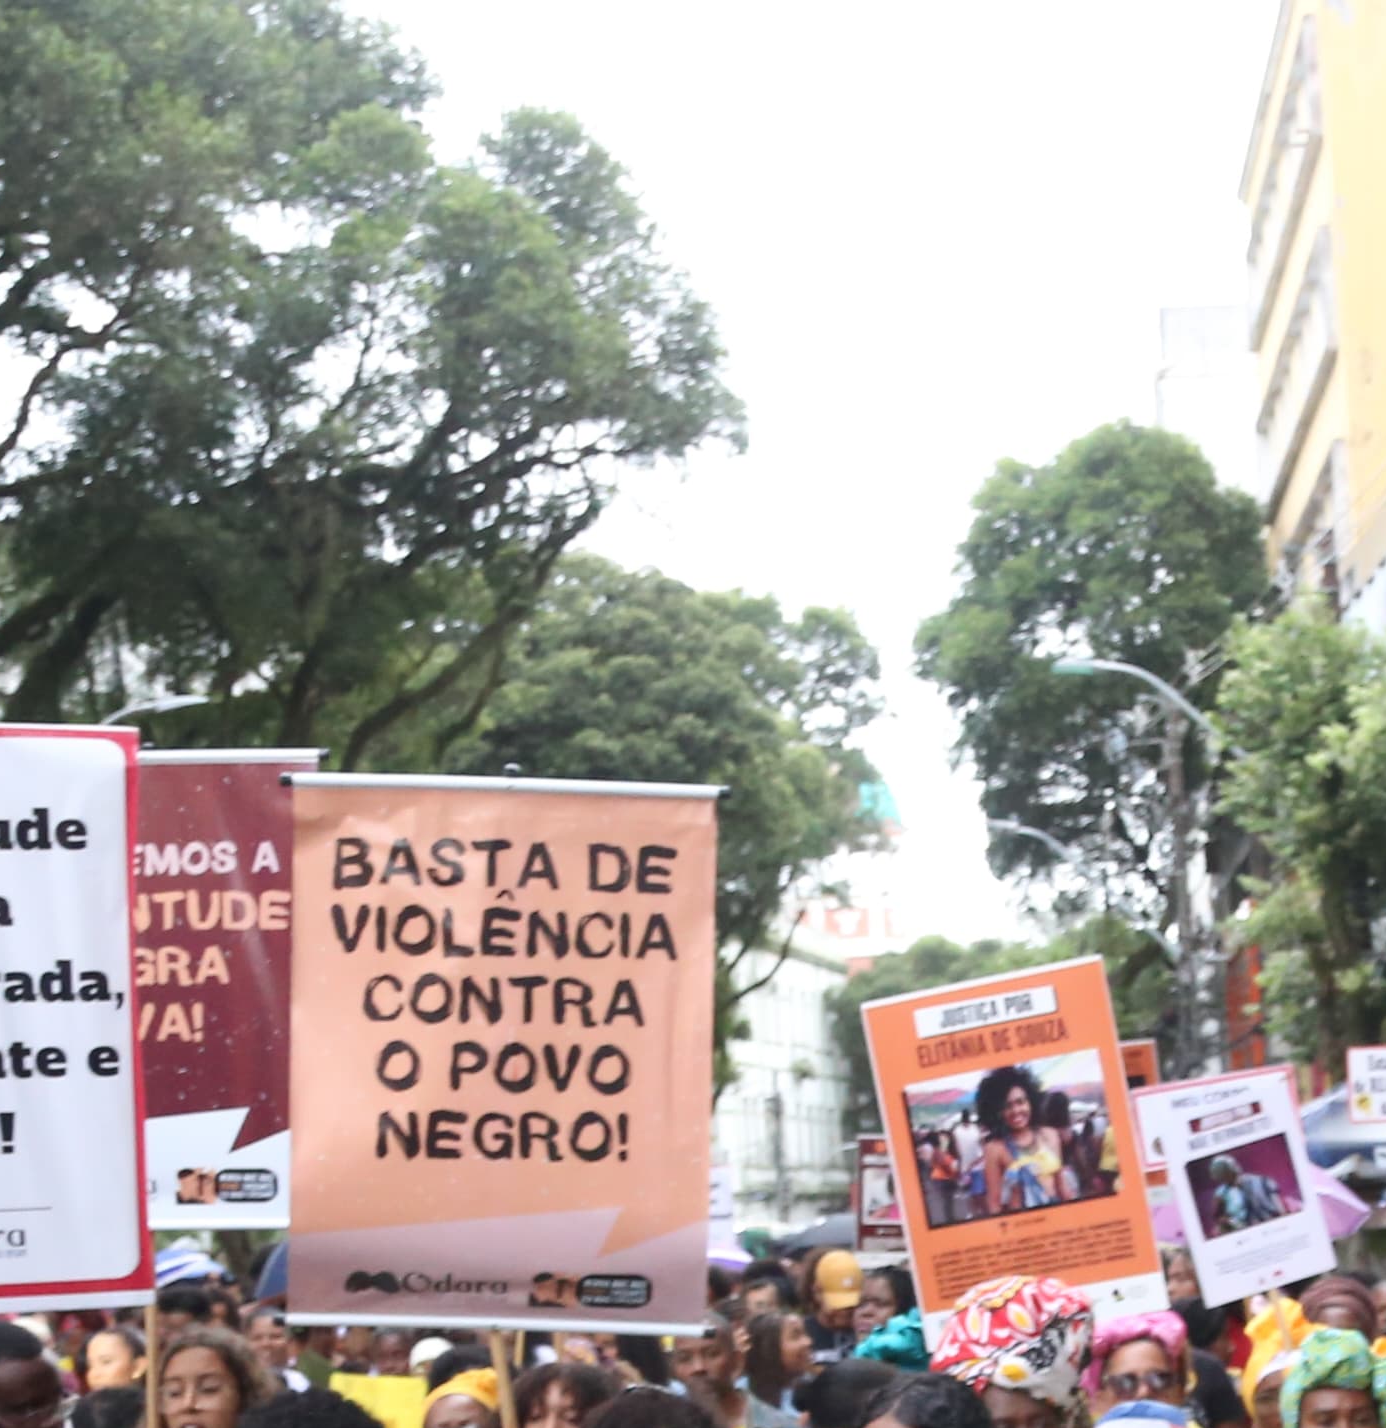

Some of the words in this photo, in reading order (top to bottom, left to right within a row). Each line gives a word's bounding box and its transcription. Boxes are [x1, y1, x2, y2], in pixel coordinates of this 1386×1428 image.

[251, 840, 281, 874] A
[333, 838, 559, 890] BASTA
[589, 843, 677, 894] DE
[331, 890, 677, 960] VIOLÊNCIA
[363, 973, 644, 1028] CONTRA
[88, 1046, 119, 1076] e
[376, 1040, 420, 1092] O
[450, 1041, 630, 1095] POVO
[376, 1110, 628, 1162] NEGRO!
[401, 1271, 509, 1295] Odara
